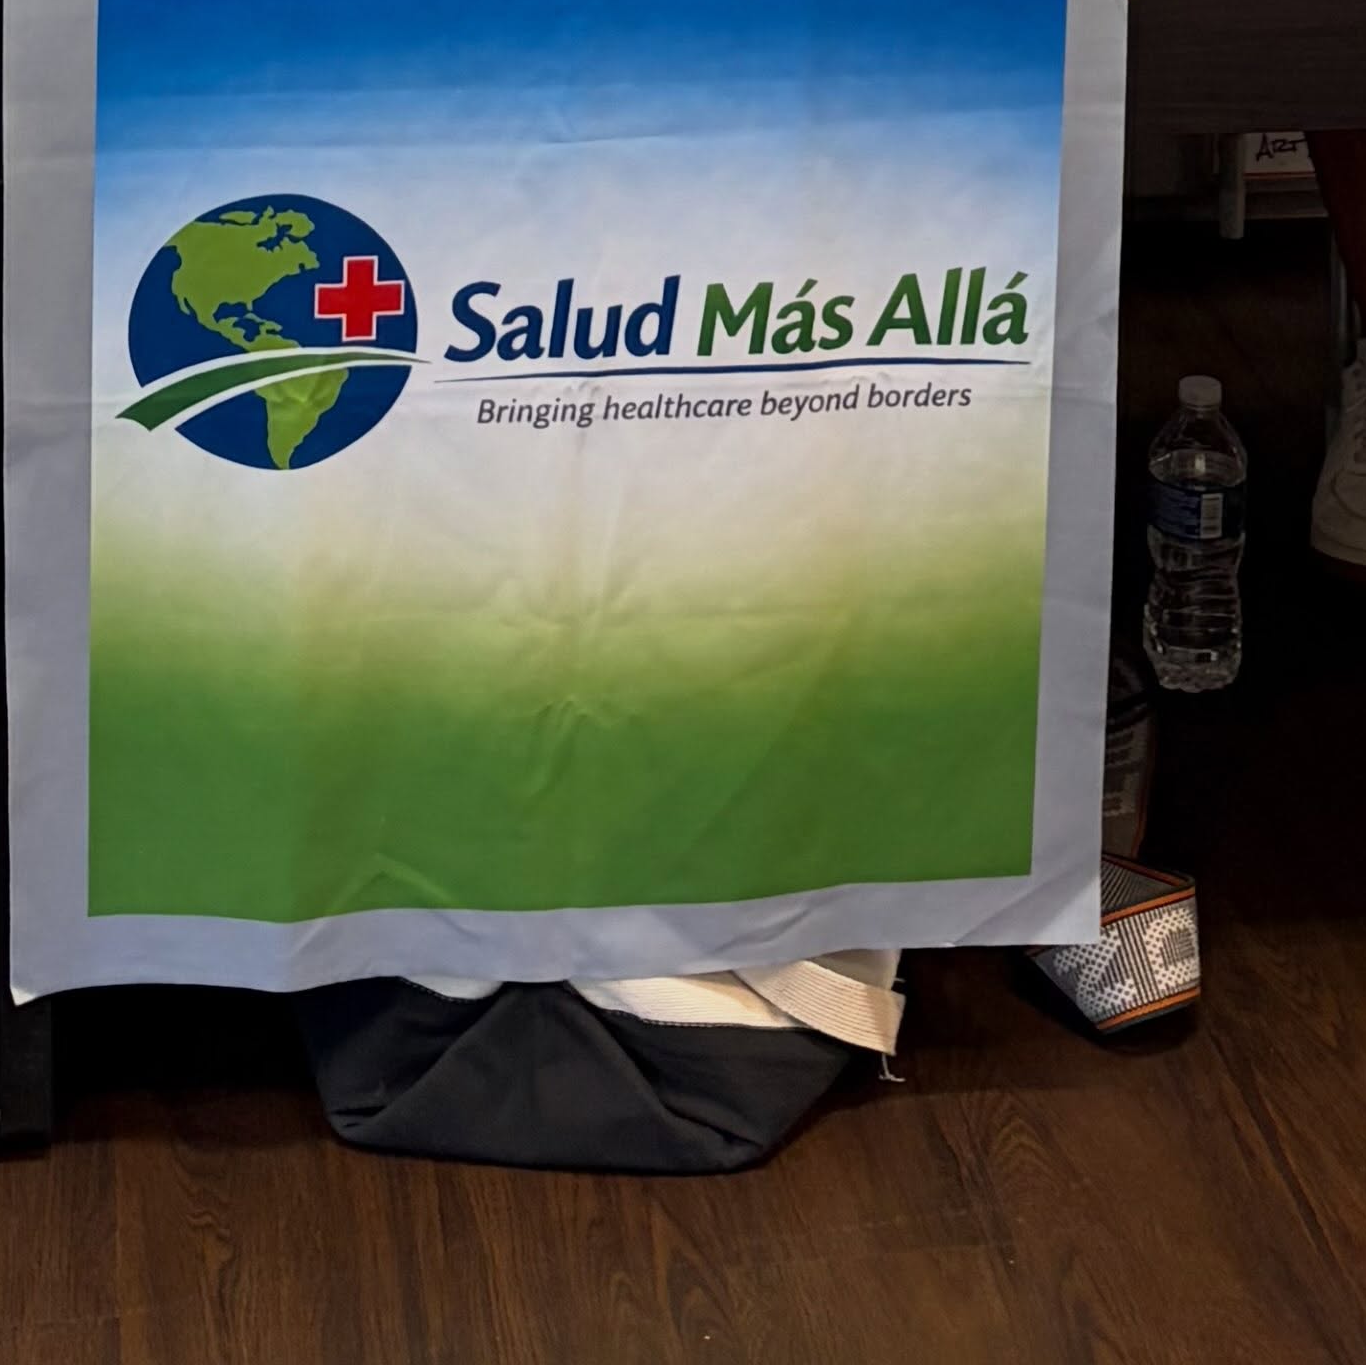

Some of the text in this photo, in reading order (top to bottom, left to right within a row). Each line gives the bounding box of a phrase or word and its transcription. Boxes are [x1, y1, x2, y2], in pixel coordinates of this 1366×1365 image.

[444, 266, 1029, 362] Salud Más Allá
[476, 381, 973, 429] Bringing healthcare beyond borders
